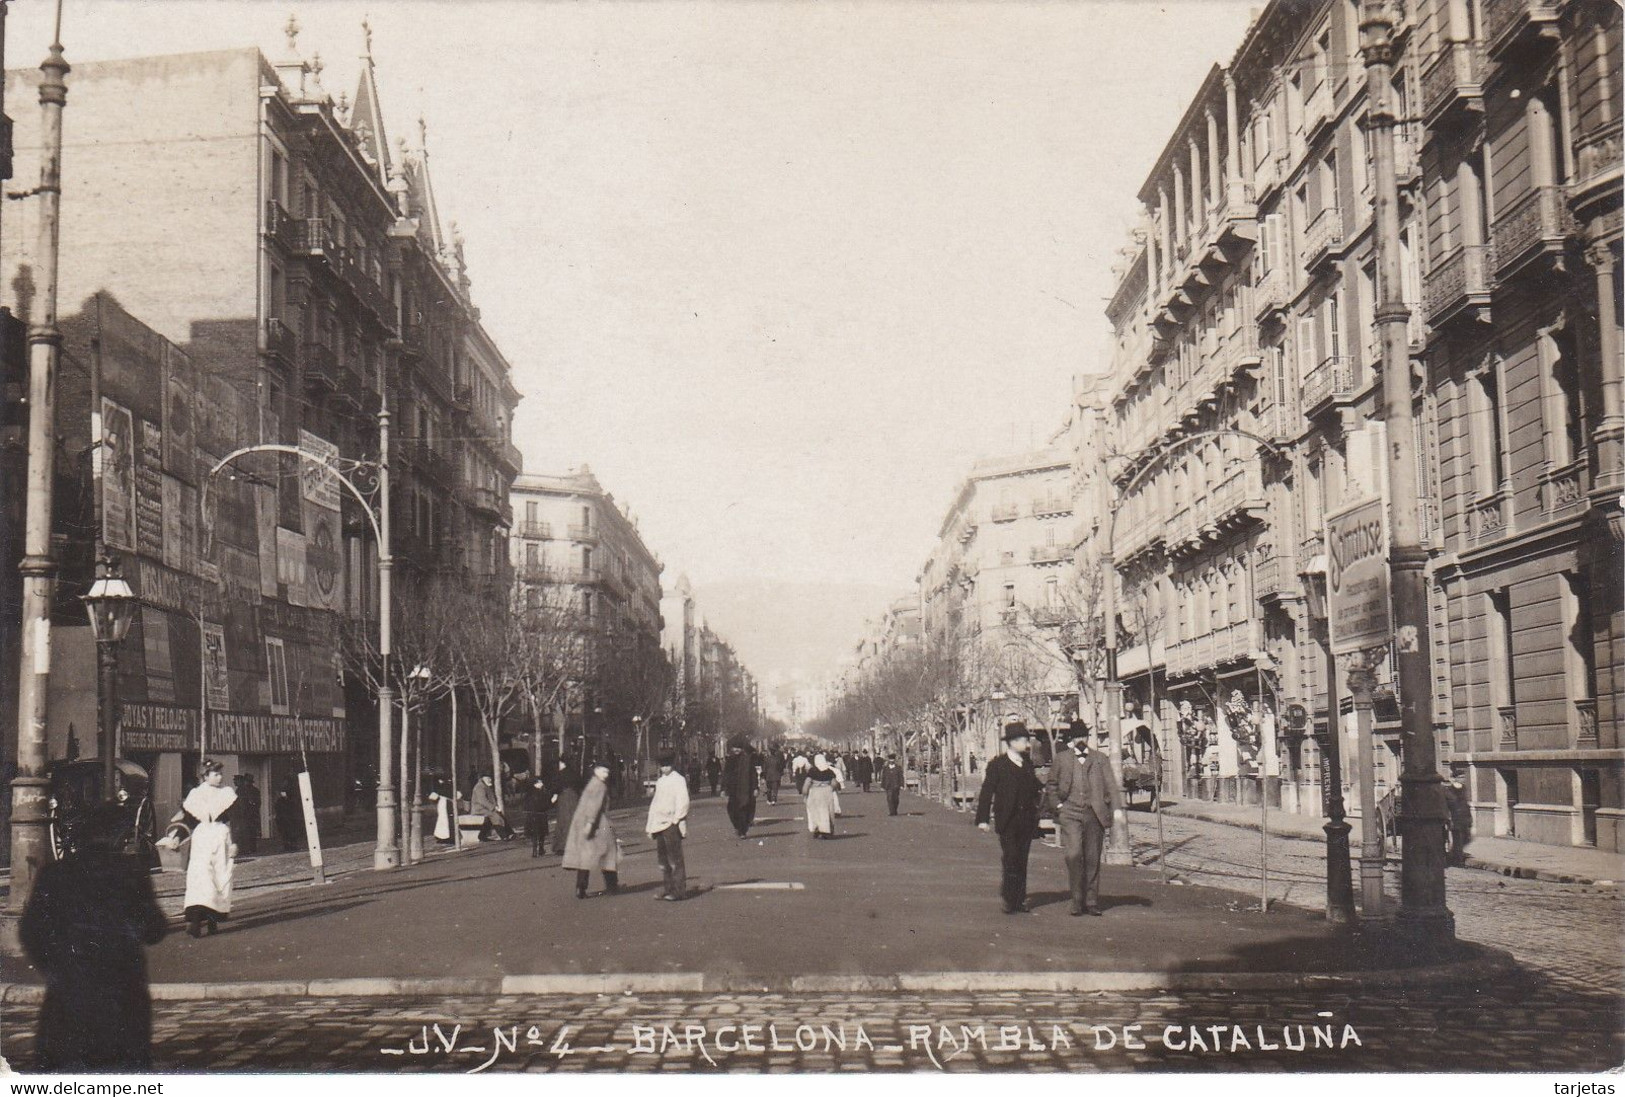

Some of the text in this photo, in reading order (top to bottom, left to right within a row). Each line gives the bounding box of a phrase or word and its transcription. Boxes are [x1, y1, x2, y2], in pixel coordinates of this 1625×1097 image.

[121, 703, 187, 730] JOYAS Y RELOJES
[211, 712, 267, 752] ARGENTINA
